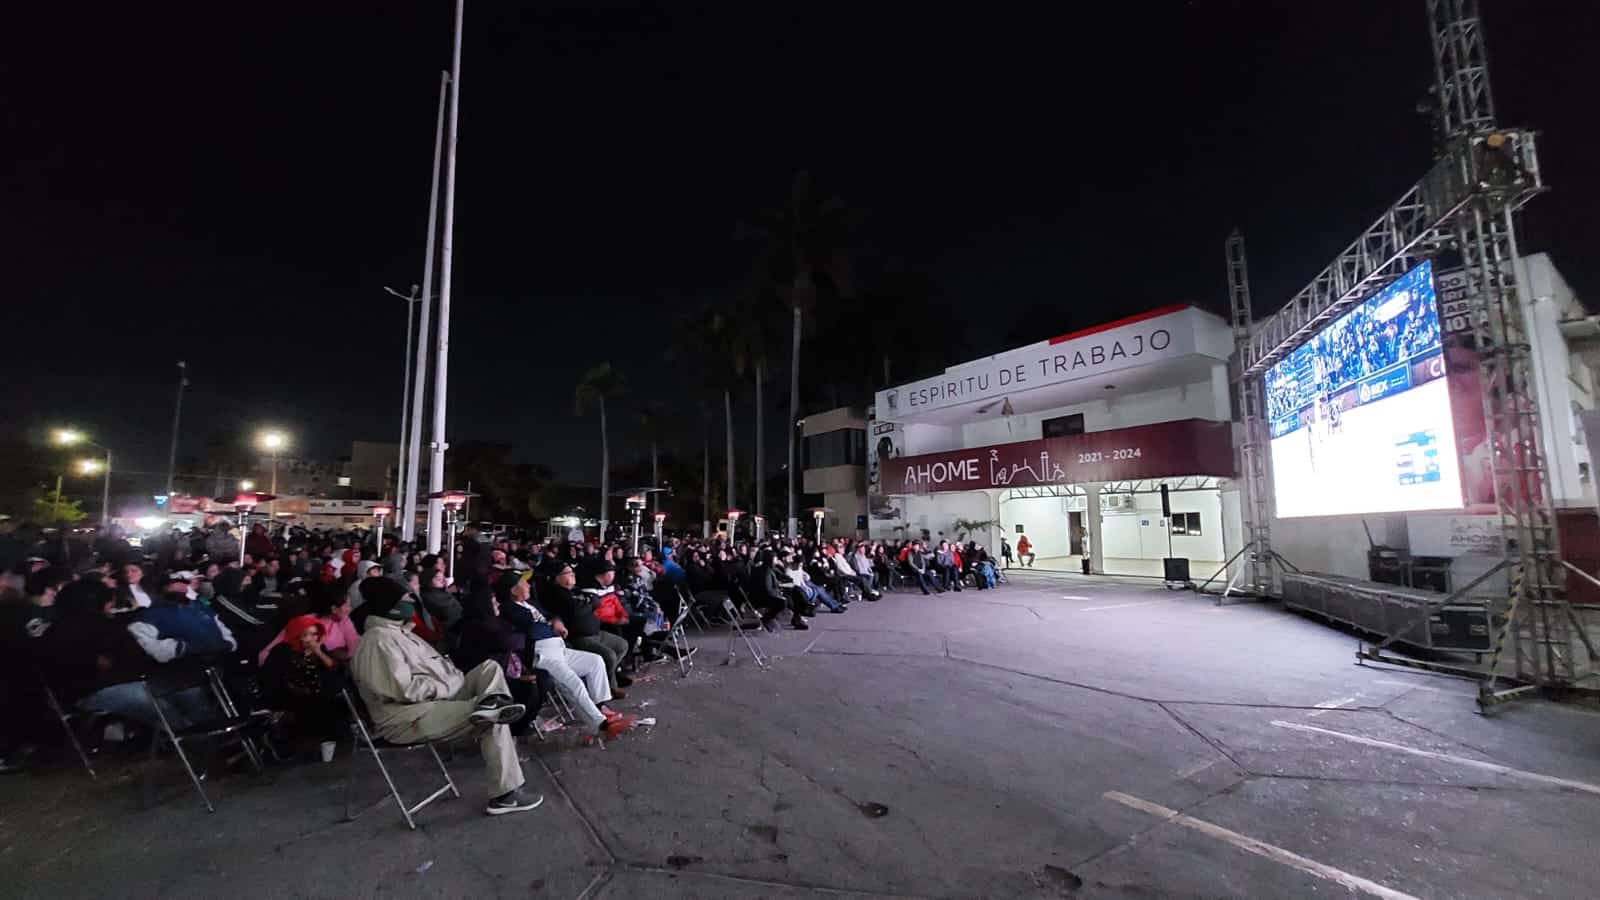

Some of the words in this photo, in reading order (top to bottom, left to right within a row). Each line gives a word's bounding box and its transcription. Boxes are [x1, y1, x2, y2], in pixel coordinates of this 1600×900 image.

[909, 373, 990, 407] ESPÍRITU
[999, 364, 1028, 387] DE
[1038, 329, 1171, 377] TRABAJO
[1077, 452, 1103, 465] 2021
[1113, 448, 1142, 461] 2024
[904, 459, 980, 485] AHOME
